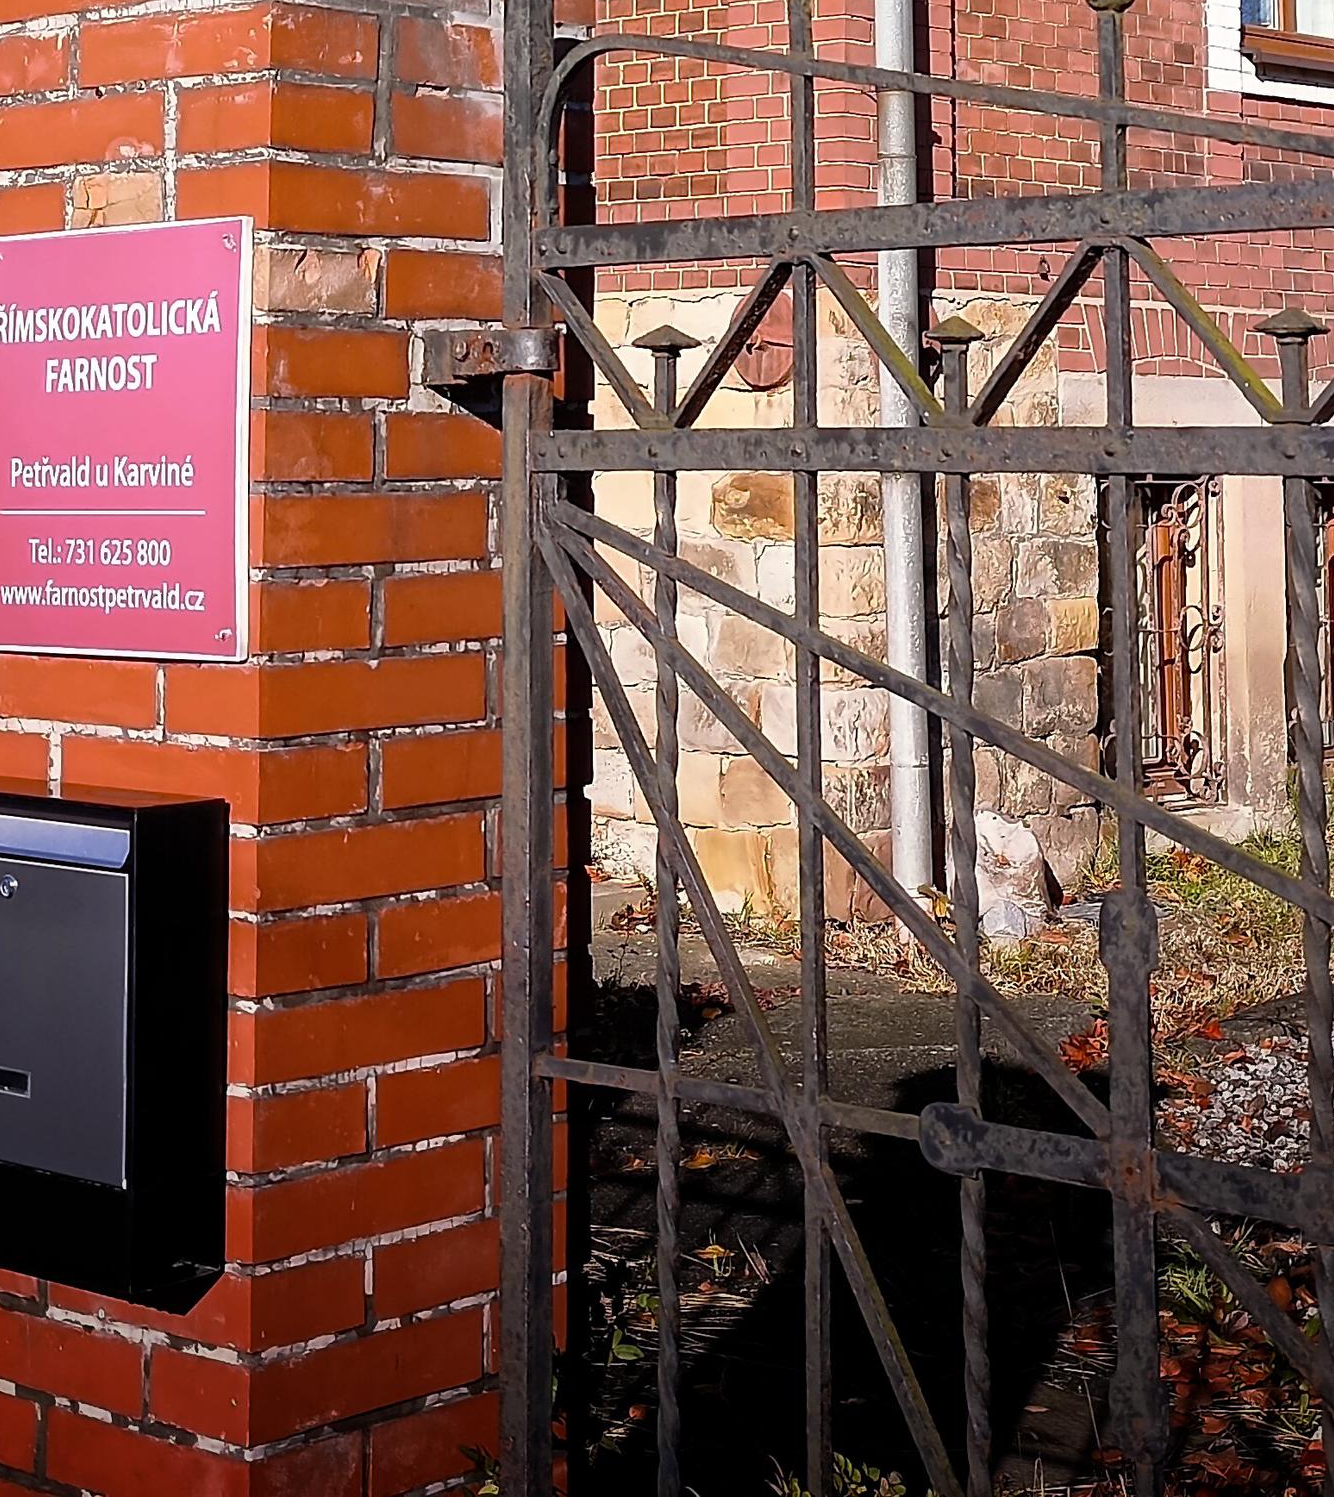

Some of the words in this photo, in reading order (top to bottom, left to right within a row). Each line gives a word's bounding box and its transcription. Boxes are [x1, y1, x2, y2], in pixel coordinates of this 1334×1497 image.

[44, 354, 159, 393] FARNOST
[10, 455, 90, 488] Petřvald
[95, 463, 109, 488] u
[113, 454, 194, 487] Karviné
[28, 538, 62, 564] Tel.:
[64, 539, 94, 565] 731
[100, 539, 134, 565] 625
[136, 539, 171, 566] 800
[0, 579, 206, 615] www.farnostpetrvald.cz
